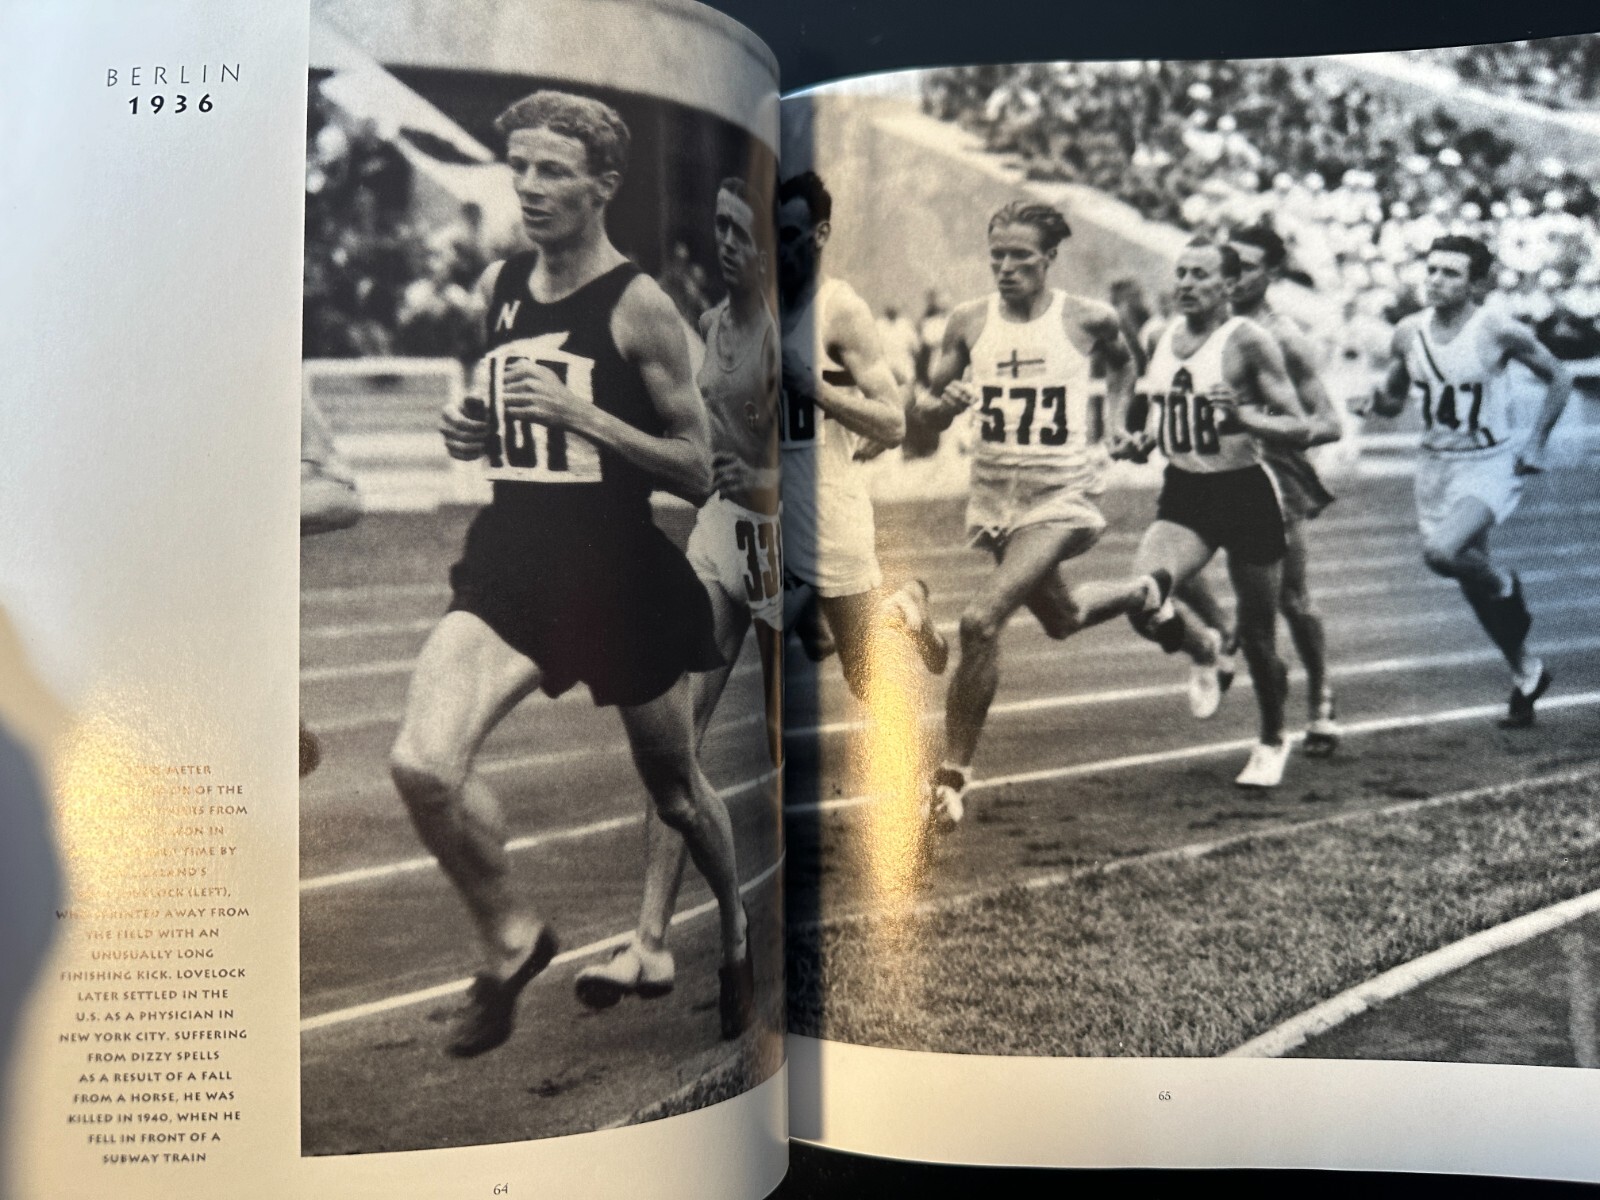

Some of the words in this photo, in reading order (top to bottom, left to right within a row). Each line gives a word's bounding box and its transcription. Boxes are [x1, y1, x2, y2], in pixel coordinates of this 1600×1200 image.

[107, 64, 240, 87] BERLIN
[129, 93, 213, 115] 1936
[495, 300, 521, 332] N
[981, 385, 1068, 445] 573
[195, 785, 212, 795] OF
[218, 785, 243, 794] THE
[209, 805, 248, 815] FROM
[210, 826, 224, 835] IN
[184, 847, 215, 856] TIME
[220, 846, 237, 855] BY
[187, 887, 231, 898] (LEFT),
[164, 908, 206, 918] AWAY
[211, 907, 249, 917] FROM
[88, 930, 112, 940] THE
[117, 929, 153, 939] FIELD
[158, 929, 194, 938] WITH
[199, 928, 219, 938] AN
[91, 949, 173, 960] UNUSUALLY
[177, 948, 214, 959] LONG
[60, 970, 132, 981] FINISHING
[137, 970, 172, 980] KICK.
[177, 968, 246, 979] LOVELOCK
[78, 991, 119, 1001] LATER
[123, 990, 178, 1000] SETTLED
[182, 989, 198, 999] IN
[202, 989, 229, 999] THE
[76, 1011, 99, 1022] U.S.
[104, 1011, 121, 1021] AS
[125, 1011, 135, 1021] A
[139, 1009, 214, 1020] PHYSICIAN
[219, 1009, 234, 1019] IN
[59, 1032, 90, 1043] NEW
[94, 1032, 132, 1042] YORK
[136, 1031, 170, 1041] CITY.
[174, 1029, 248, 1040] SUFFERING
[87, 1052, 126, 1063] FROM
[131, 1052, 173, 1062] DIZZY
[177, 1050, 220, 1061] SPELLS
[79, 1073, 95, 1083] AS
[99, 1073, 109, 1083] A
[114, 1072, 162, 1082] RESULT
[165, 1072, 184, 1081] OF
[187, 1071, 197, 1080] A
[201, 1070, 233, 1080] FALL
[73, 1093, 112, 1103] FROM
[116, 1093, 126, 1103] A
[131, 1092, 179, 1103] HORSE,
[184, 1091, 201, 1101] HE
[205, 1090, 235, 1100] WAS
[1158, 1090, 1171, 1101] 65
[68, 1113, 113, 1124] KILLED
[118, 1113, 133, 1123] IN
[137, 1112, 173, 1123] 1940,
[177, 1111, 218, 1121] WHEN
[223, 1111, 241, 1120] HE
[88, 1134, 116, 1144] FELL
[121, 1133, 136, 1143] IN
[141, 1132, 186, 1143] FRONT
[190, 1132, 207, 1142] OF
[211, 1131, 221, 1141] A
[103, 1153, 160, 1164] SUBWAY
[163, 1152, 207, 1162] TRAIN
[493, 1182, 509, 1195] 64
